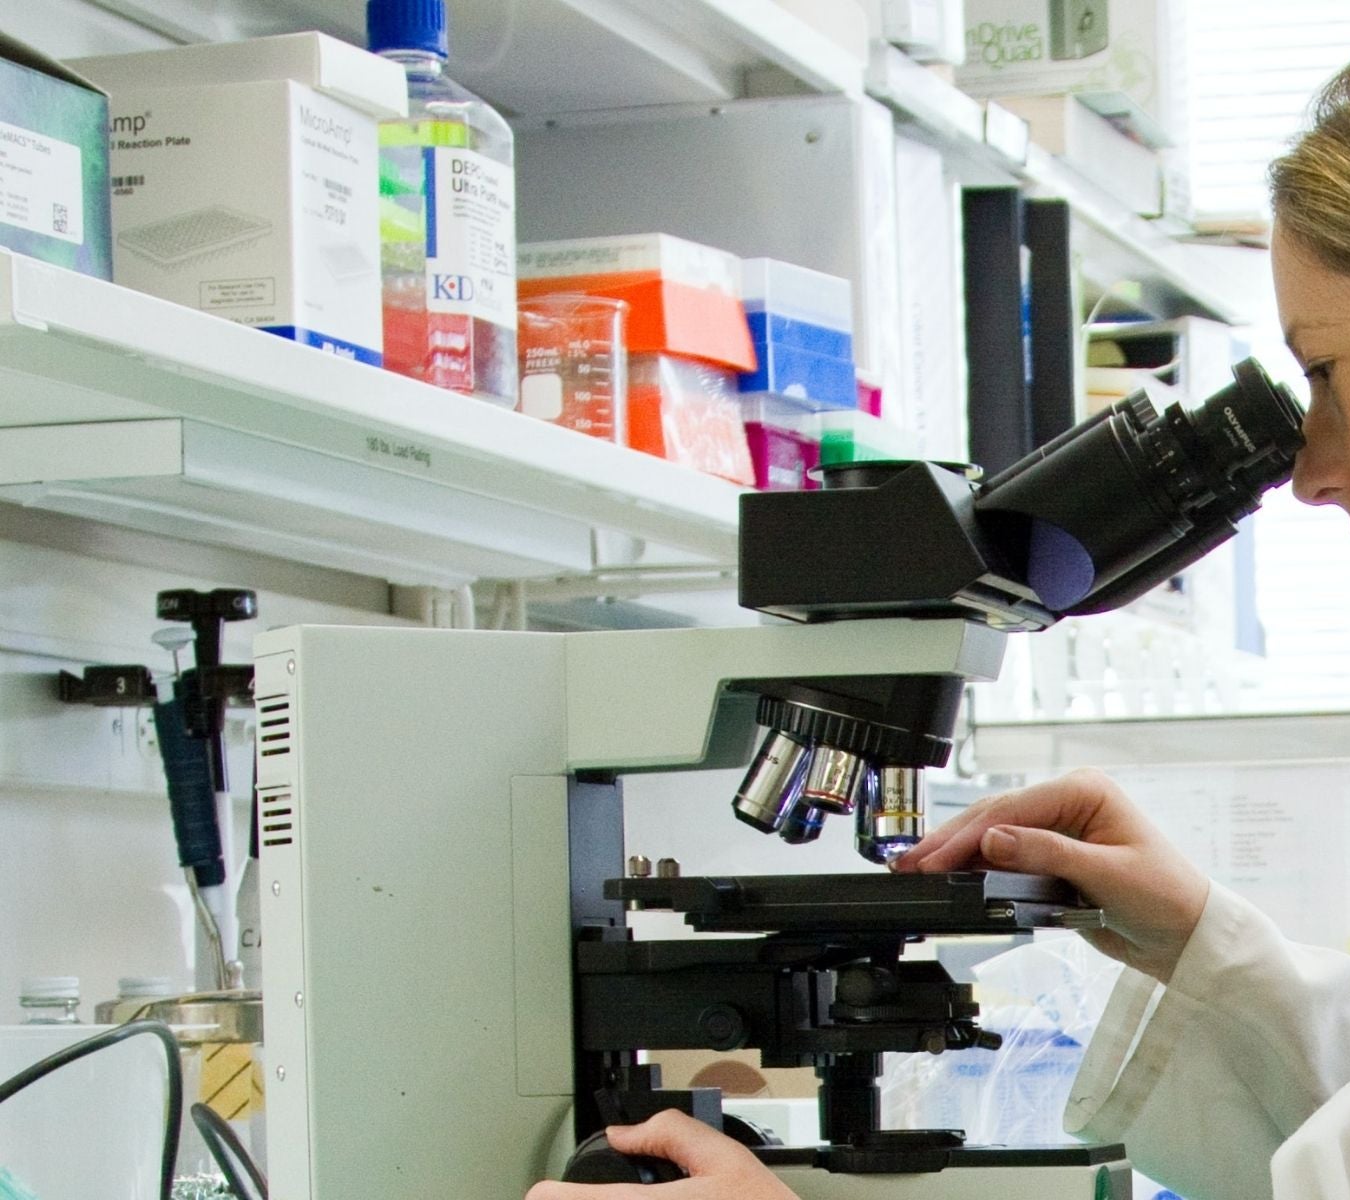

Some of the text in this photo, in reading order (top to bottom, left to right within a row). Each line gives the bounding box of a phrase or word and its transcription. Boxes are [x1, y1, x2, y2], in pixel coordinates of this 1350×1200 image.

[982, 37, 1041, 69] Quad
[118, 140, 162, 150] Reaction
[165, 137, 191, 147] Plate
[578, 364, 591, 374] 50
[1223, 406, 1257, 453] OLYMPUS
[116, 676, 126, 694] 3
